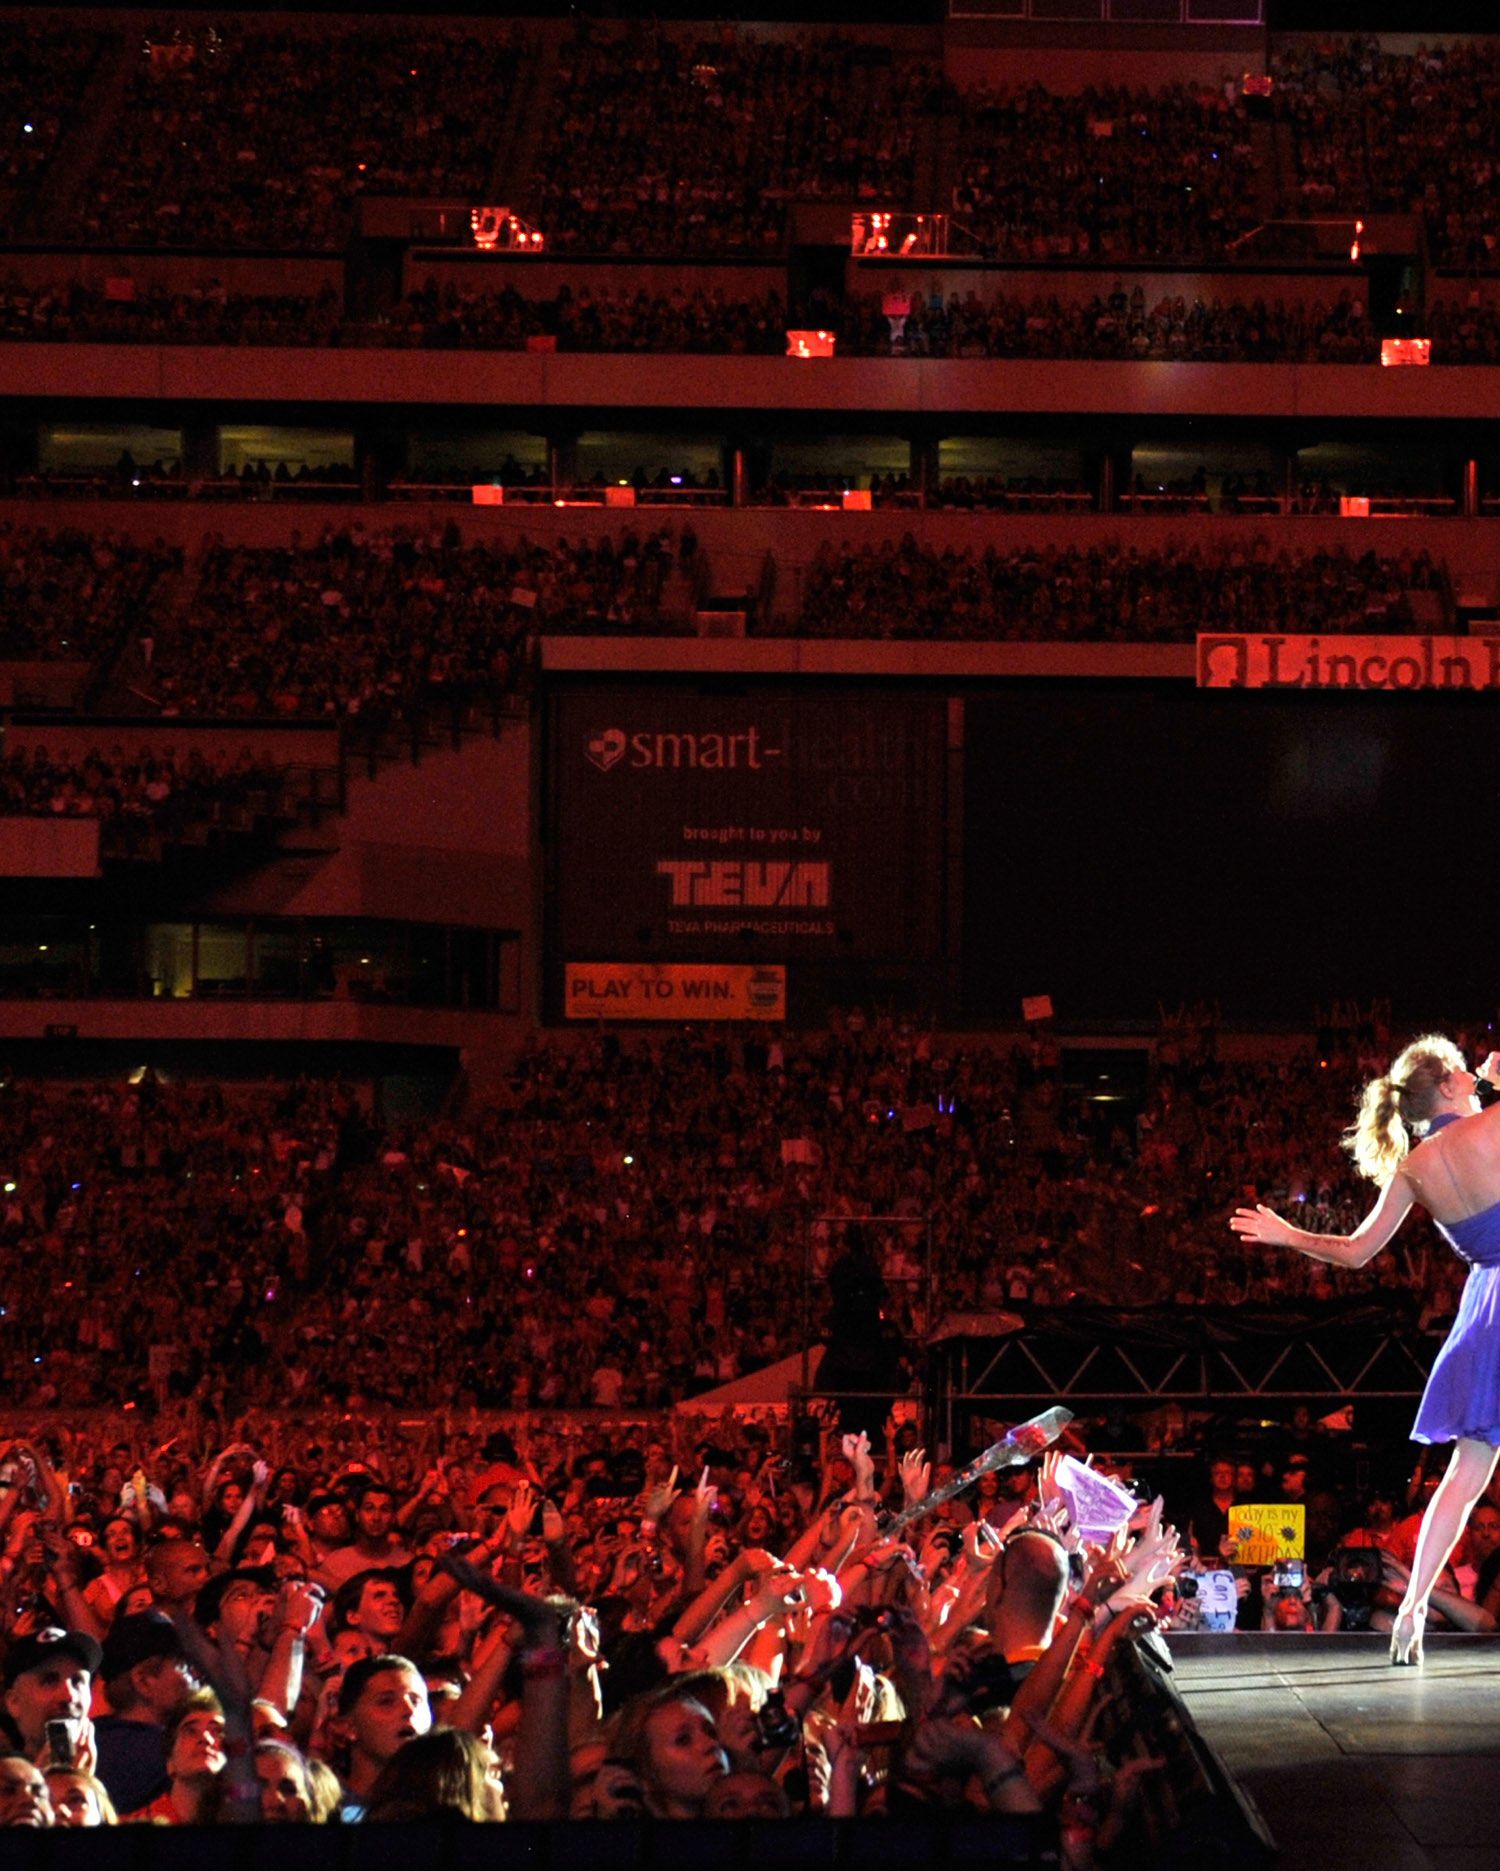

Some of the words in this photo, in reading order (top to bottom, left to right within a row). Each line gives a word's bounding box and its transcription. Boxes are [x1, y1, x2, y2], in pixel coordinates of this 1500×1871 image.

[1262, 637, 1472, 690] Lincoln
[683, 826, 744, 843] brought
[750, 826, 765, 841] to
[769, 827, 799, 843] you
[802, 826, 822, 843] by
[657, 860, 832, 906] TEVA
[572, 979, 632, 998] PLAY
[640, 979, 674, 998] TO
[682, 979, 735, 999] WIN.
